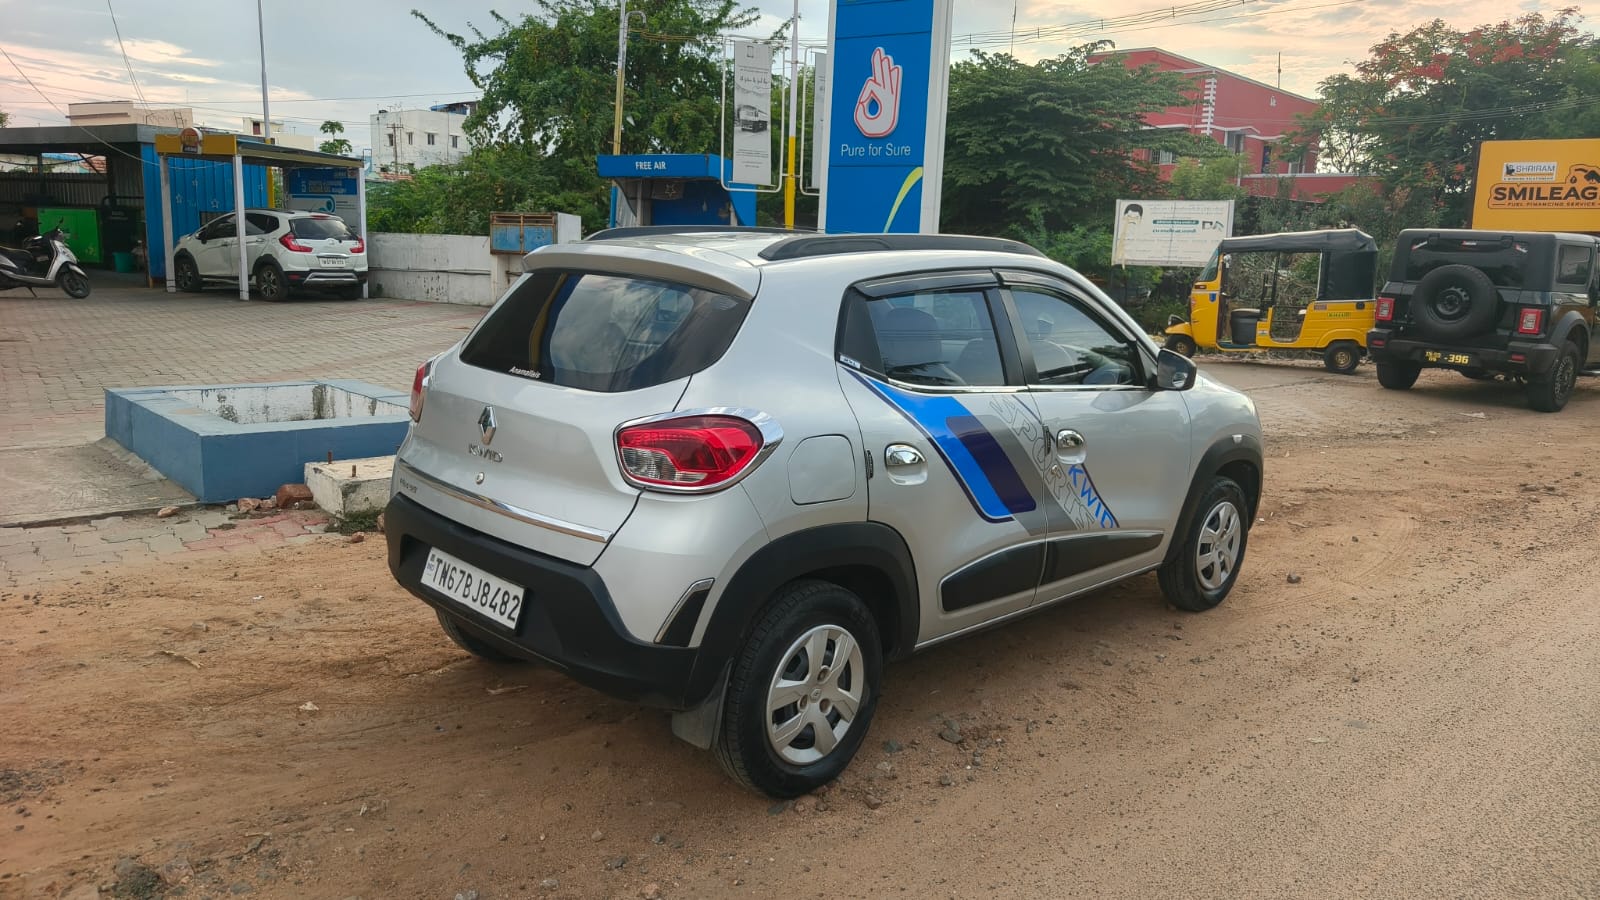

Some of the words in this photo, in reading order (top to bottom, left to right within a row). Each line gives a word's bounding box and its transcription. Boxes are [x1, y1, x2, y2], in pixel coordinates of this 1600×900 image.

[841, 144, 865, 157] Pure
[868, 143, 883, 156] for
[885, 143, 911, 156] Sure
[635, 161, 652, 170] FREE
[653, 161, 667, 170] AIR
[1516, 164, 1555, 173] SHRIRAM
[1493, 186, 1600, 201] SMILEAG
[469, 443, 503, 463] KWID
[1068, 464, 1115, 529] KWID
[432, 557, 521, 622] TN67BJ8482
